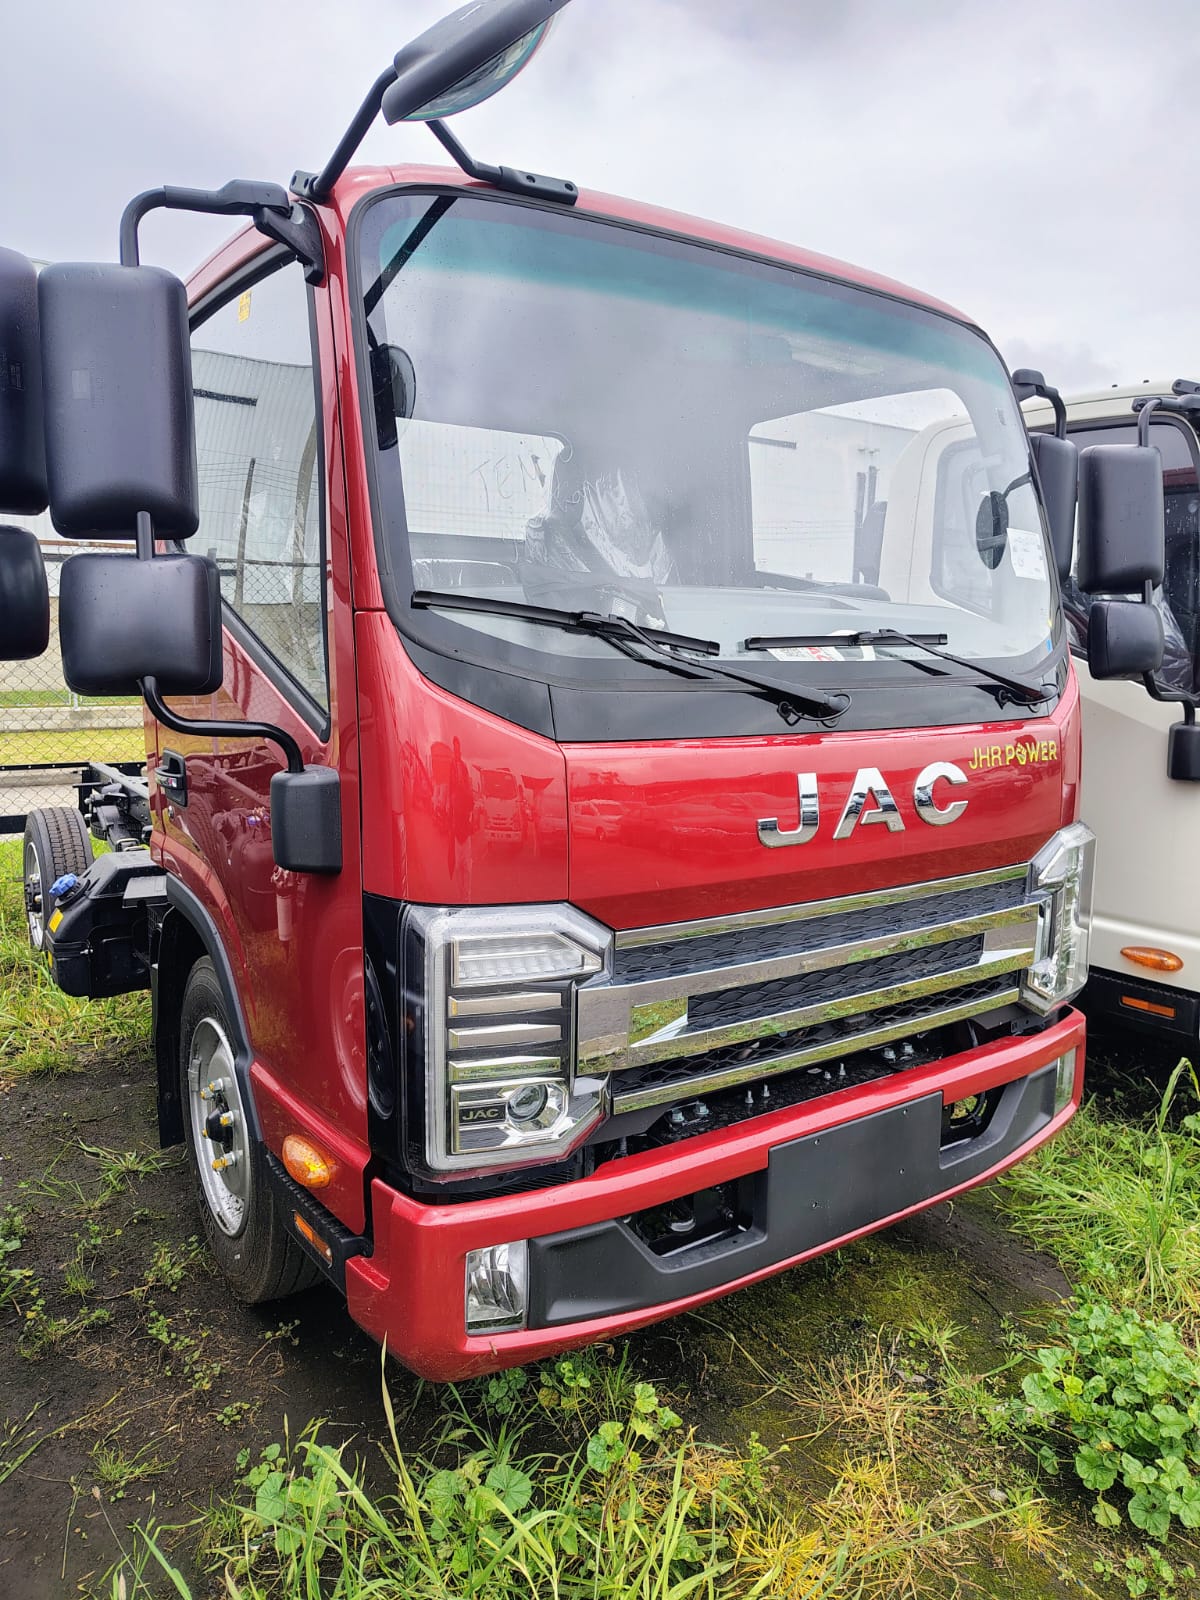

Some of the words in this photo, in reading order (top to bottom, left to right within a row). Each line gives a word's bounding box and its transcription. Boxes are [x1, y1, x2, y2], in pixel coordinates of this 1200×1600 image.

[968, 745, 1003, 770] JHR
[757, 761, 969, 849] JAC
[462, 1109, 499, 1120] JAC
